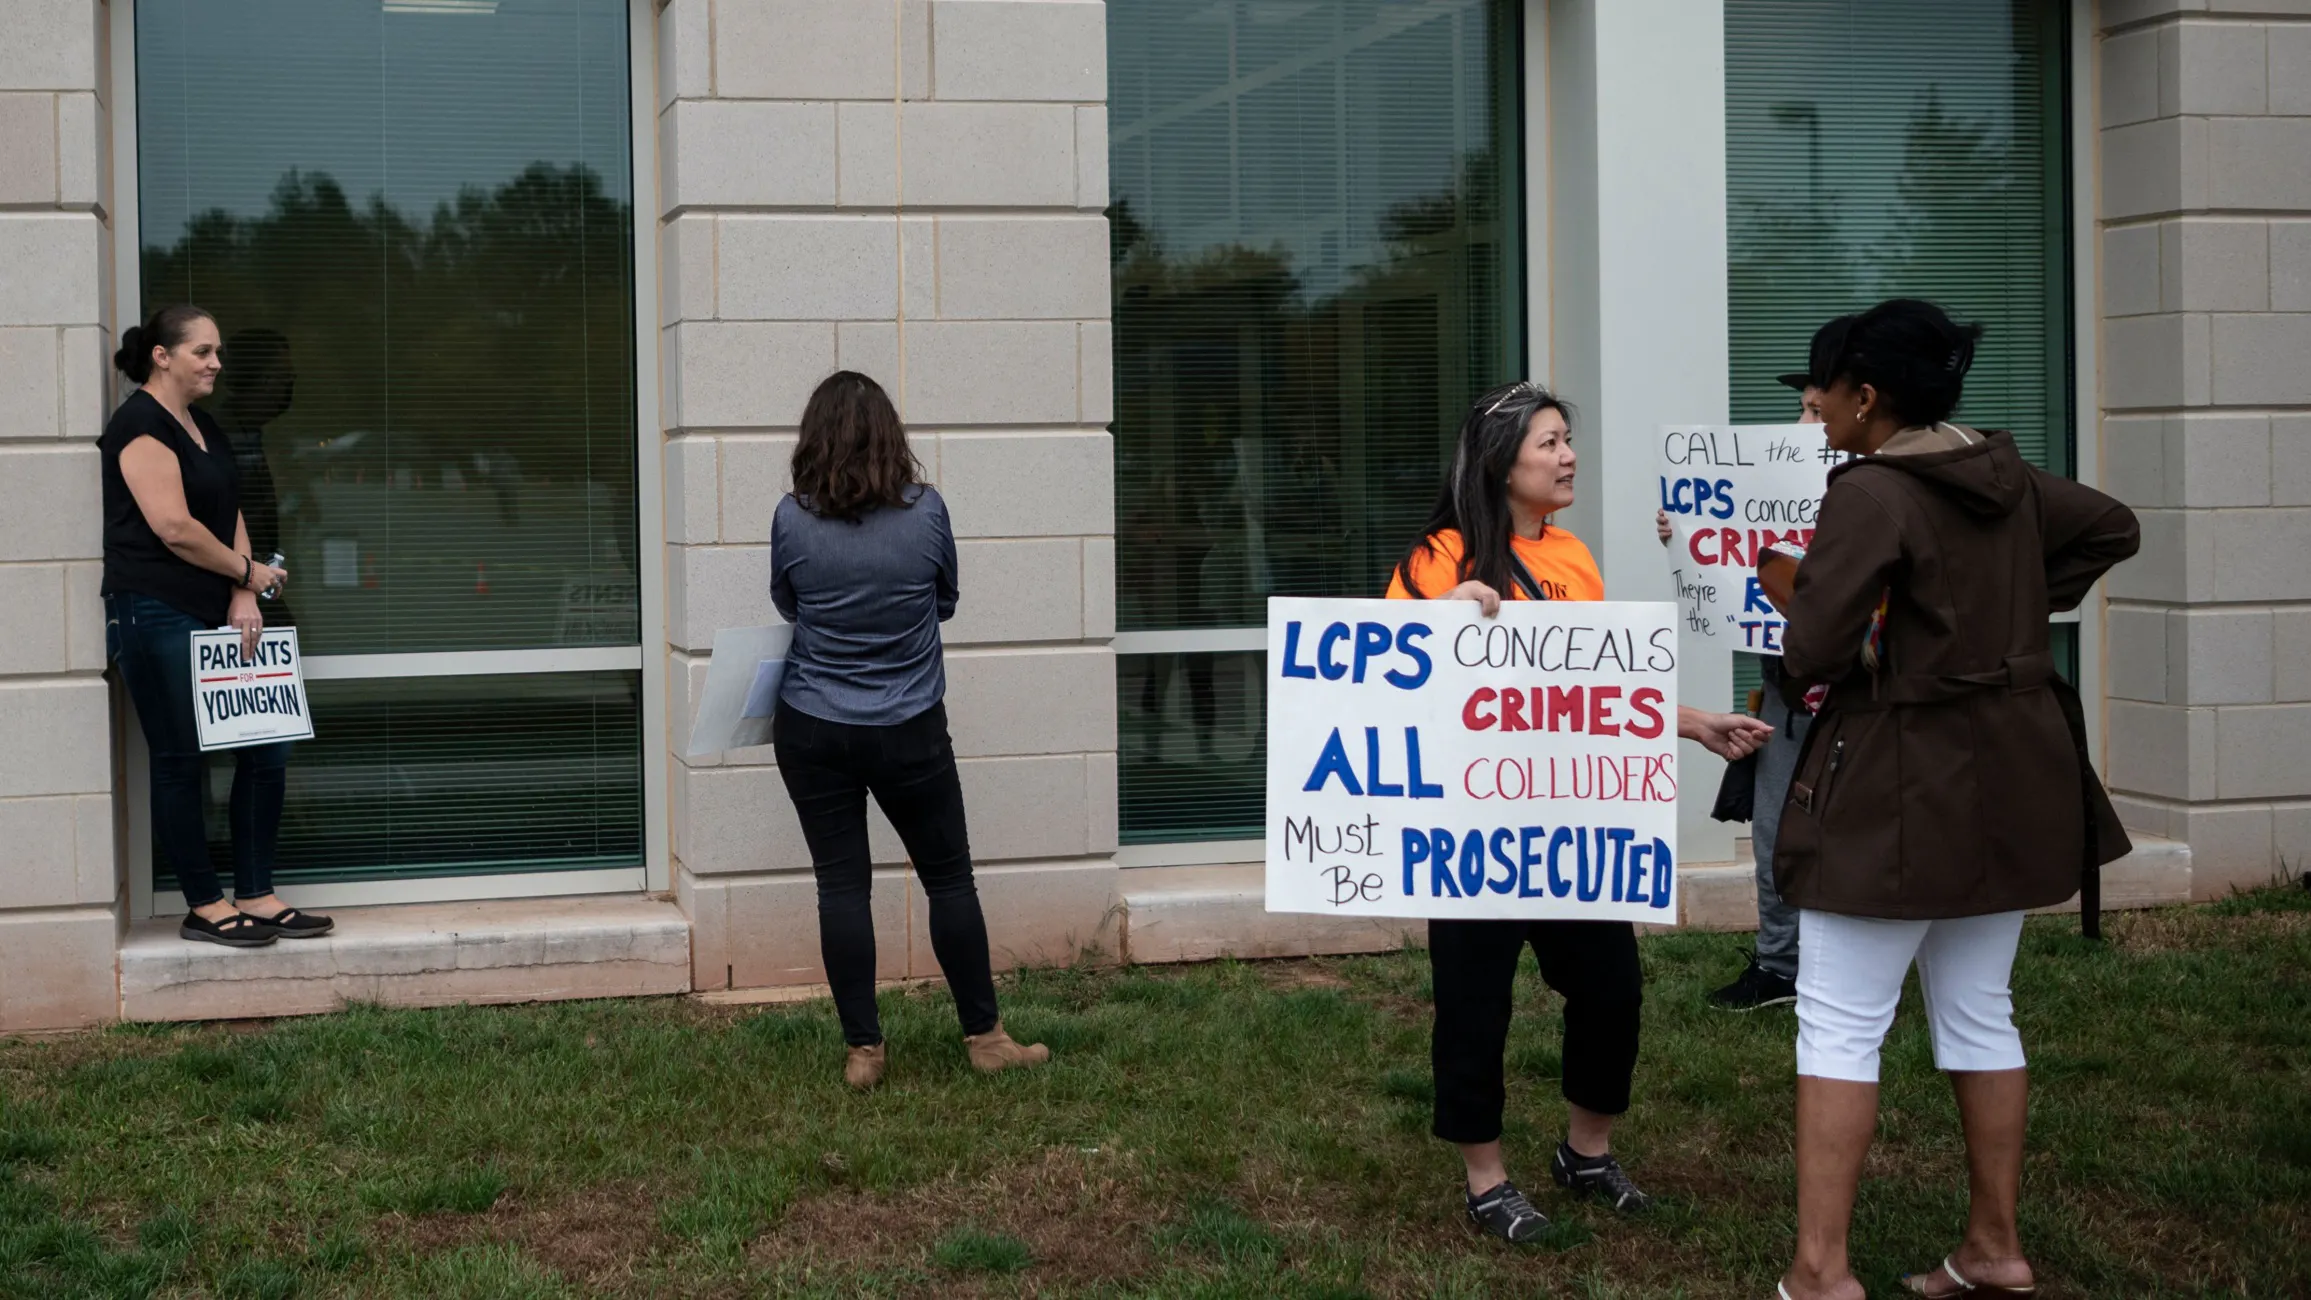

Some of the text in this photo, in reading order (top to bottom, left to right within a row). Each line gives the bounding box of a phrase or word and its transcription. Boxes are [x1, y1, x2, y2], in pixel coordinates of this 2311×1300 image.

[1665, 432, 1754, 467] CALL
[1765, 437, 1805, 463] the
[1660, 475, 1735, 520] LCPS
[1686, 607, 1716, 637] the
[239, 672, 255, 683] FOR
[1281, 621, 1675, 691] LCPS CONCEALS
[202, 683, 301, 725] YOUNGKIN
[1461, 685, 1665, 740] CRIMES
[1302, 726, 1677, 803] ALL COLLUDERS
[1284, 813, 1673, 909] Must PROSECUTED
[1320, 865, 1384, 907] Be
